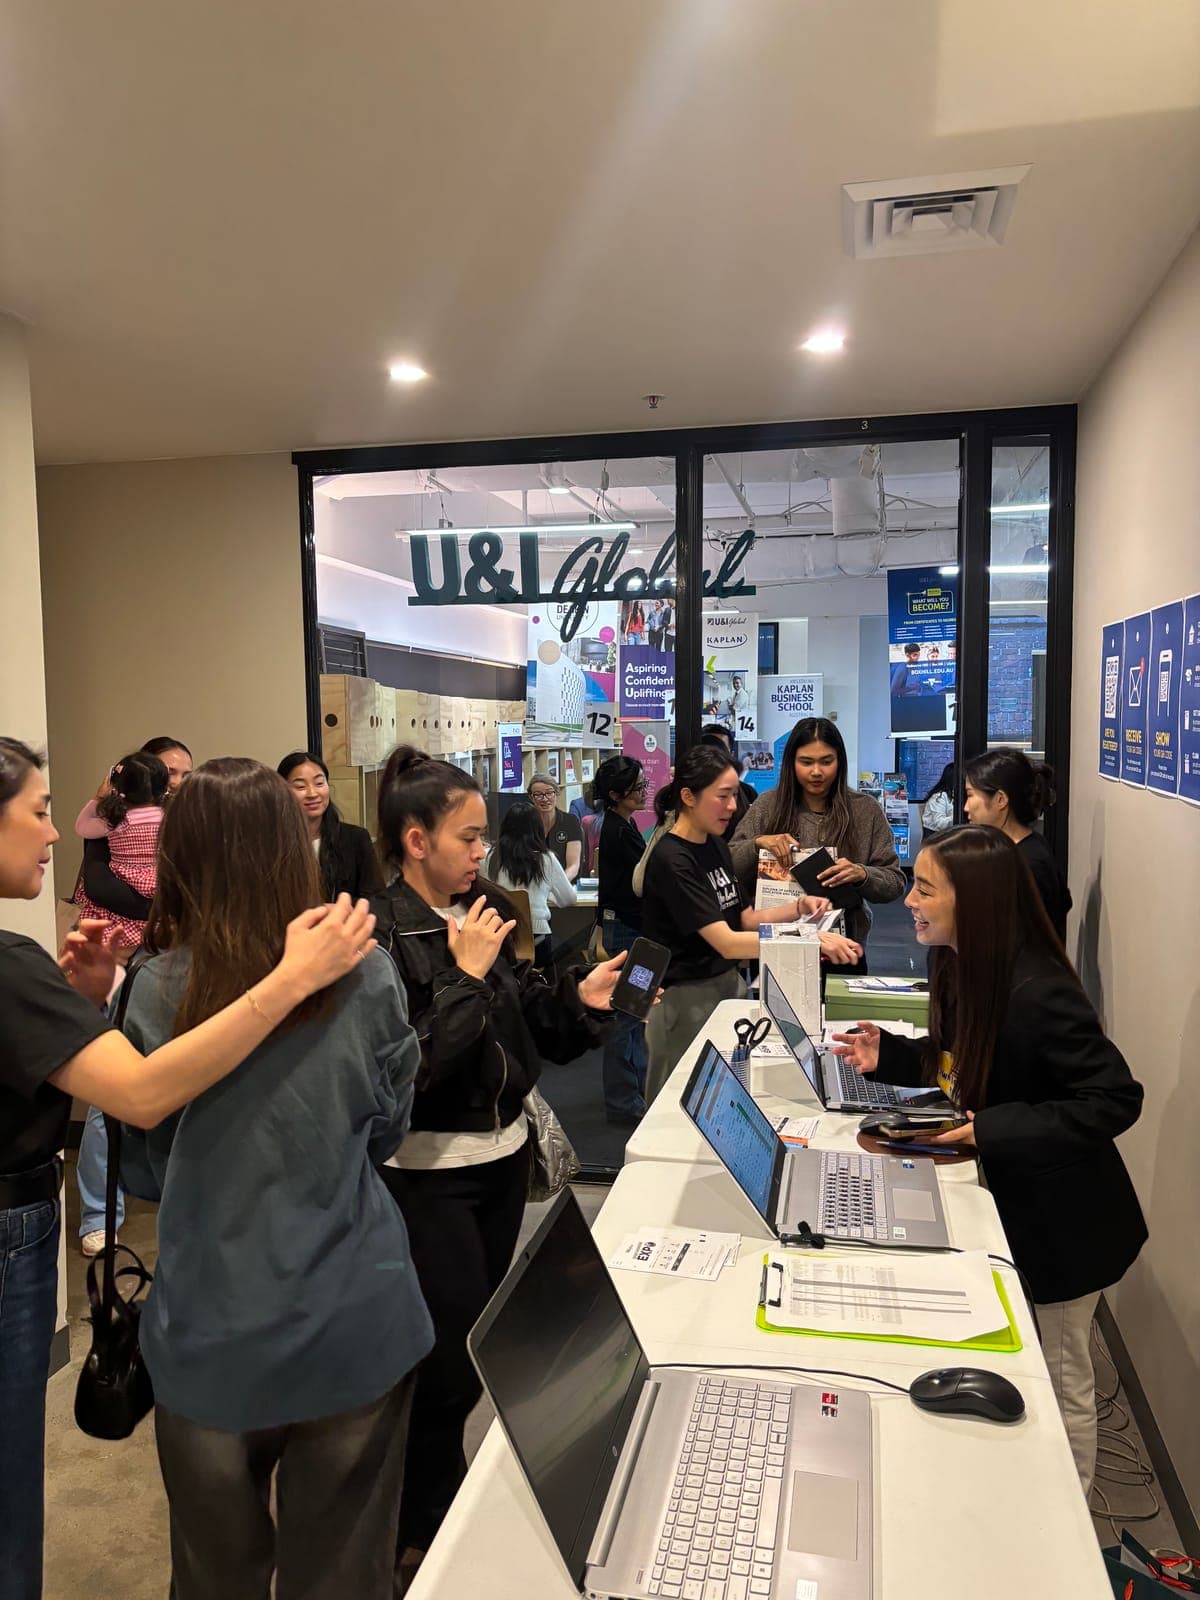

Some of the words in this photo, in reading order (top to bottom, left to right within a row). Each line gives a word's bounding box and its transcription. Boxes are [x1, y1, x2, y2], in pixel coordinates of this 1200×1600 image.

[861, 420, 869, 430] 3
[409, 530, 541, 602] U&I
[552, 530, 756, 643] Globl
[912, 602, 950, 612] BECOME?
[706, 635, 743, 644] KAPLAN
[625, 663, 667, 675] Aspiring
[625, 675, 674, 686] Confident
[625, 687, 667, 700] Uplifting
[777, 684, 814, 693] KAPLAN
[771, 693, 814, 703] BUSINESS
[777, 703, 814, 711] SCHOOL
[586, 712, 611, 736] 12
[737, 716, 755, 732] 14
[1125, 729, 1142, 744] RECEIVE
[1155, 731, 1170, 747] SHOW
